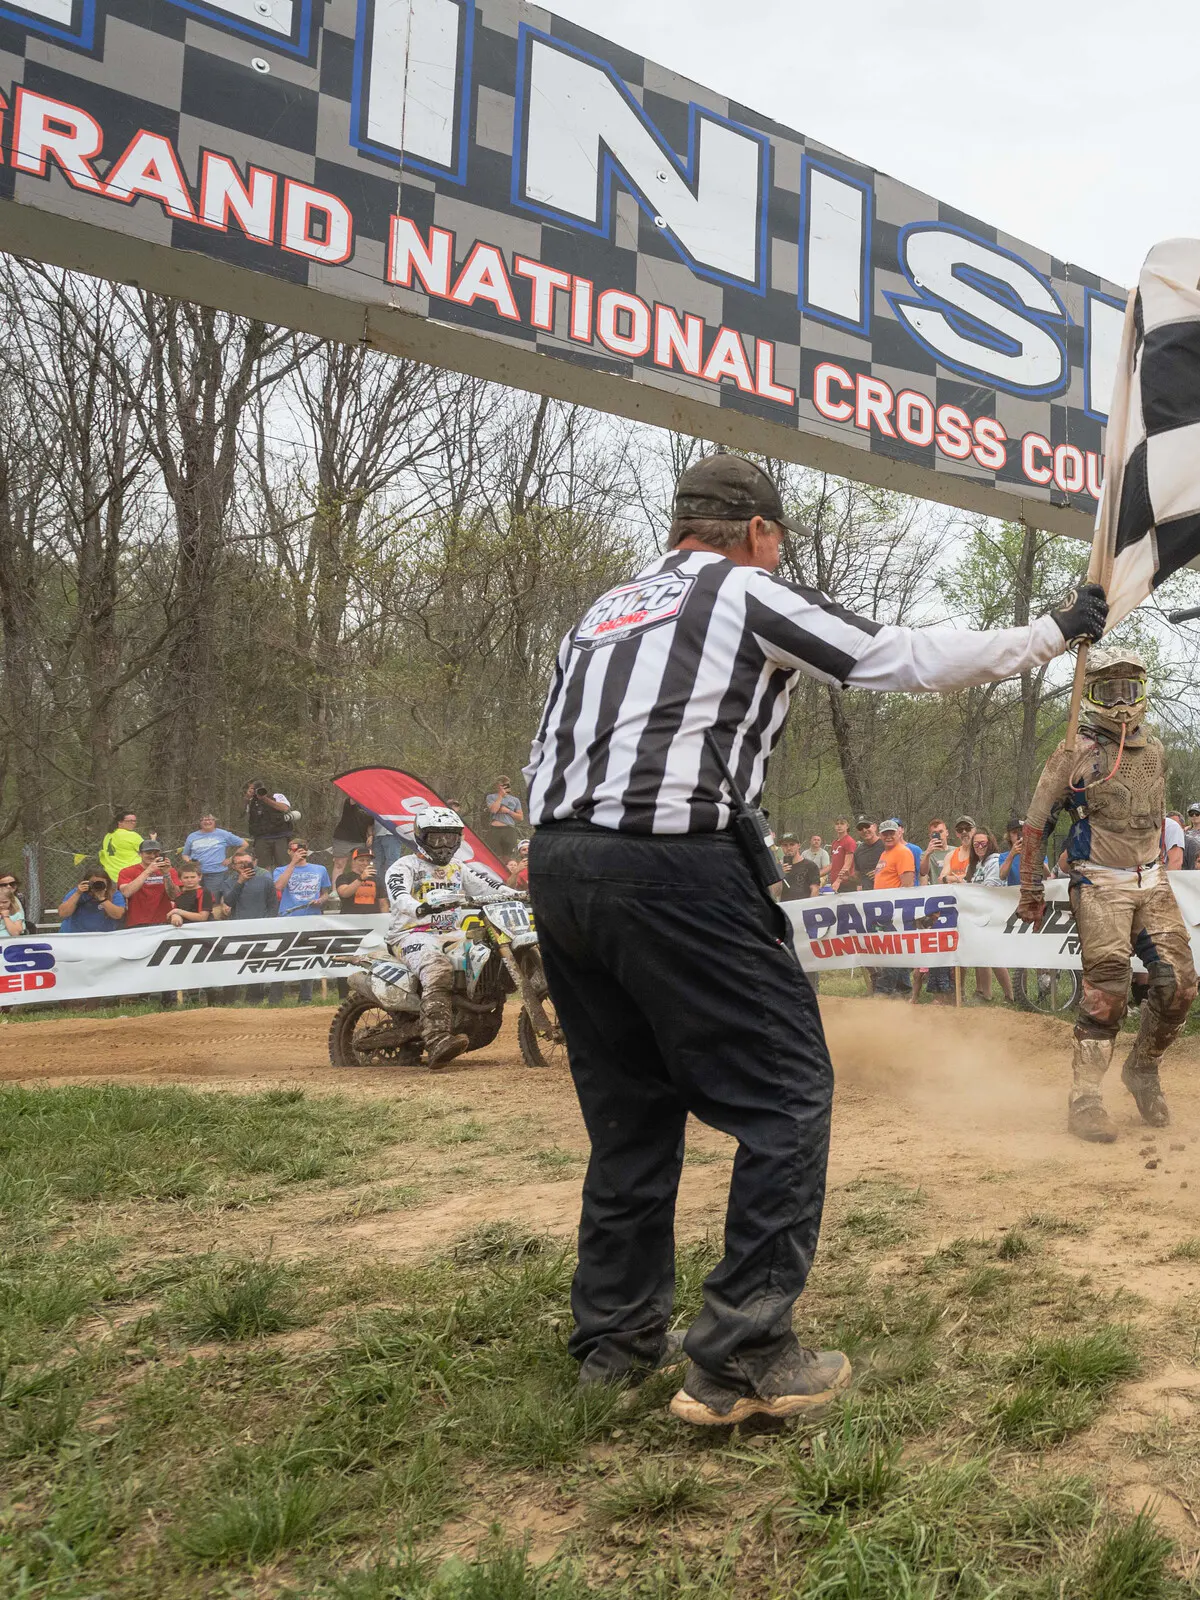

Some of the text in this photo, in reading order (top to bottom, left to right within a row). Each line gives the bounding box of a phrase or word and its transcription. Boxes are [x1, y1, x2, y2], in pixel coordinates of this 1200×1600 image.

[0, 85, 353, 266] RAND
[388, 213, 794, 407] NATIONAL
[812, 362, 1007, 471] CROSS
[594, 609, 649, 635] RACING
[500, 909, 529, 927] 111
[802, 895, 959, 940] PARTS
[147, 928, 375, 968] MOOSE
[810, 930, 959, 959] UNLIMITED
[375, 964, 407, 984] 111
